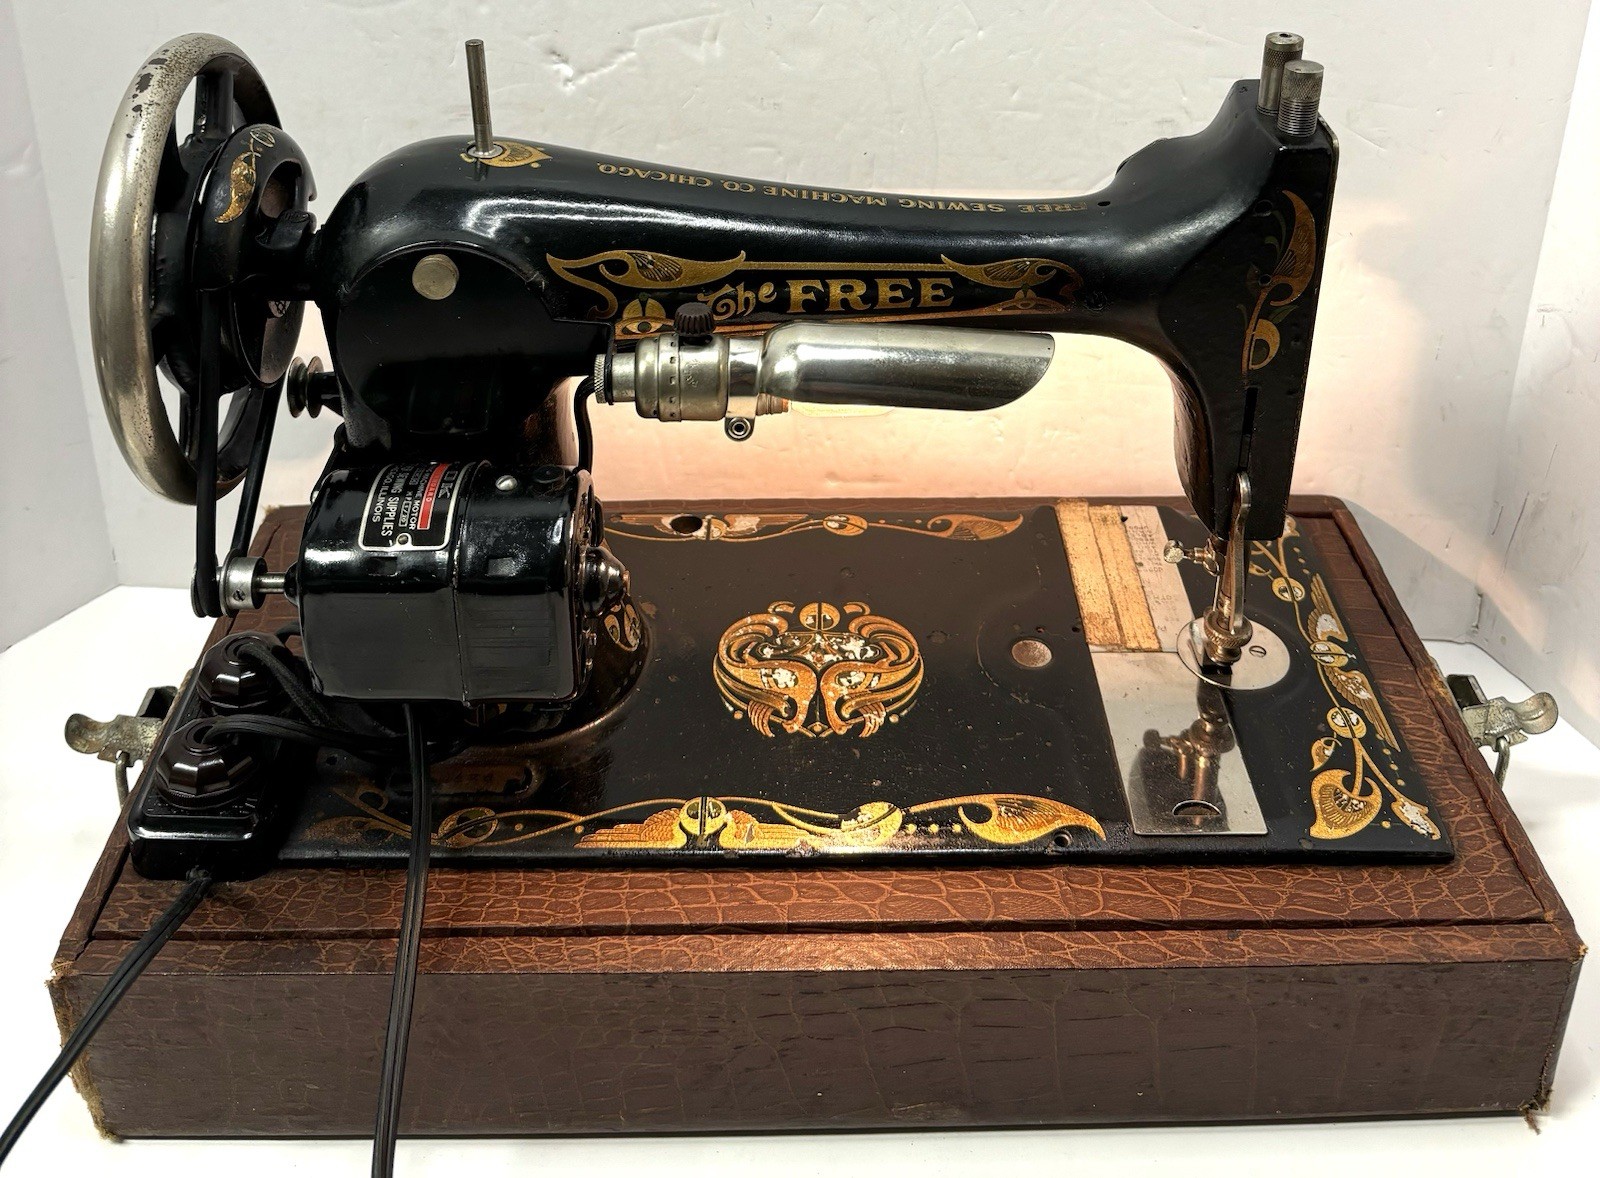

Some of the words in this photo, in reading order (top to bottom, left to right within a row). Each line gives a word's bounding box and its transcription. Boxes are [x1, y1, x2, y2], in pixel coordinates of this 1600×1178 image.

[597, 162, 713, 188] CHICAGO.
[720, 179, 756, 193] CO.
[763, 185, 888, 207] MACHINE
[898, 198, 1007, 213] SEWING
[1017, 202, 1088, 214] FREE
[697, 281, 778, 321] The
[786, 278, 955, 313] FREE
[372, 485, 390, 523] ILLINOIS
[381, 496, 400, 537] SUPPLIES
[408, 500, 420, 530] MOTOR
